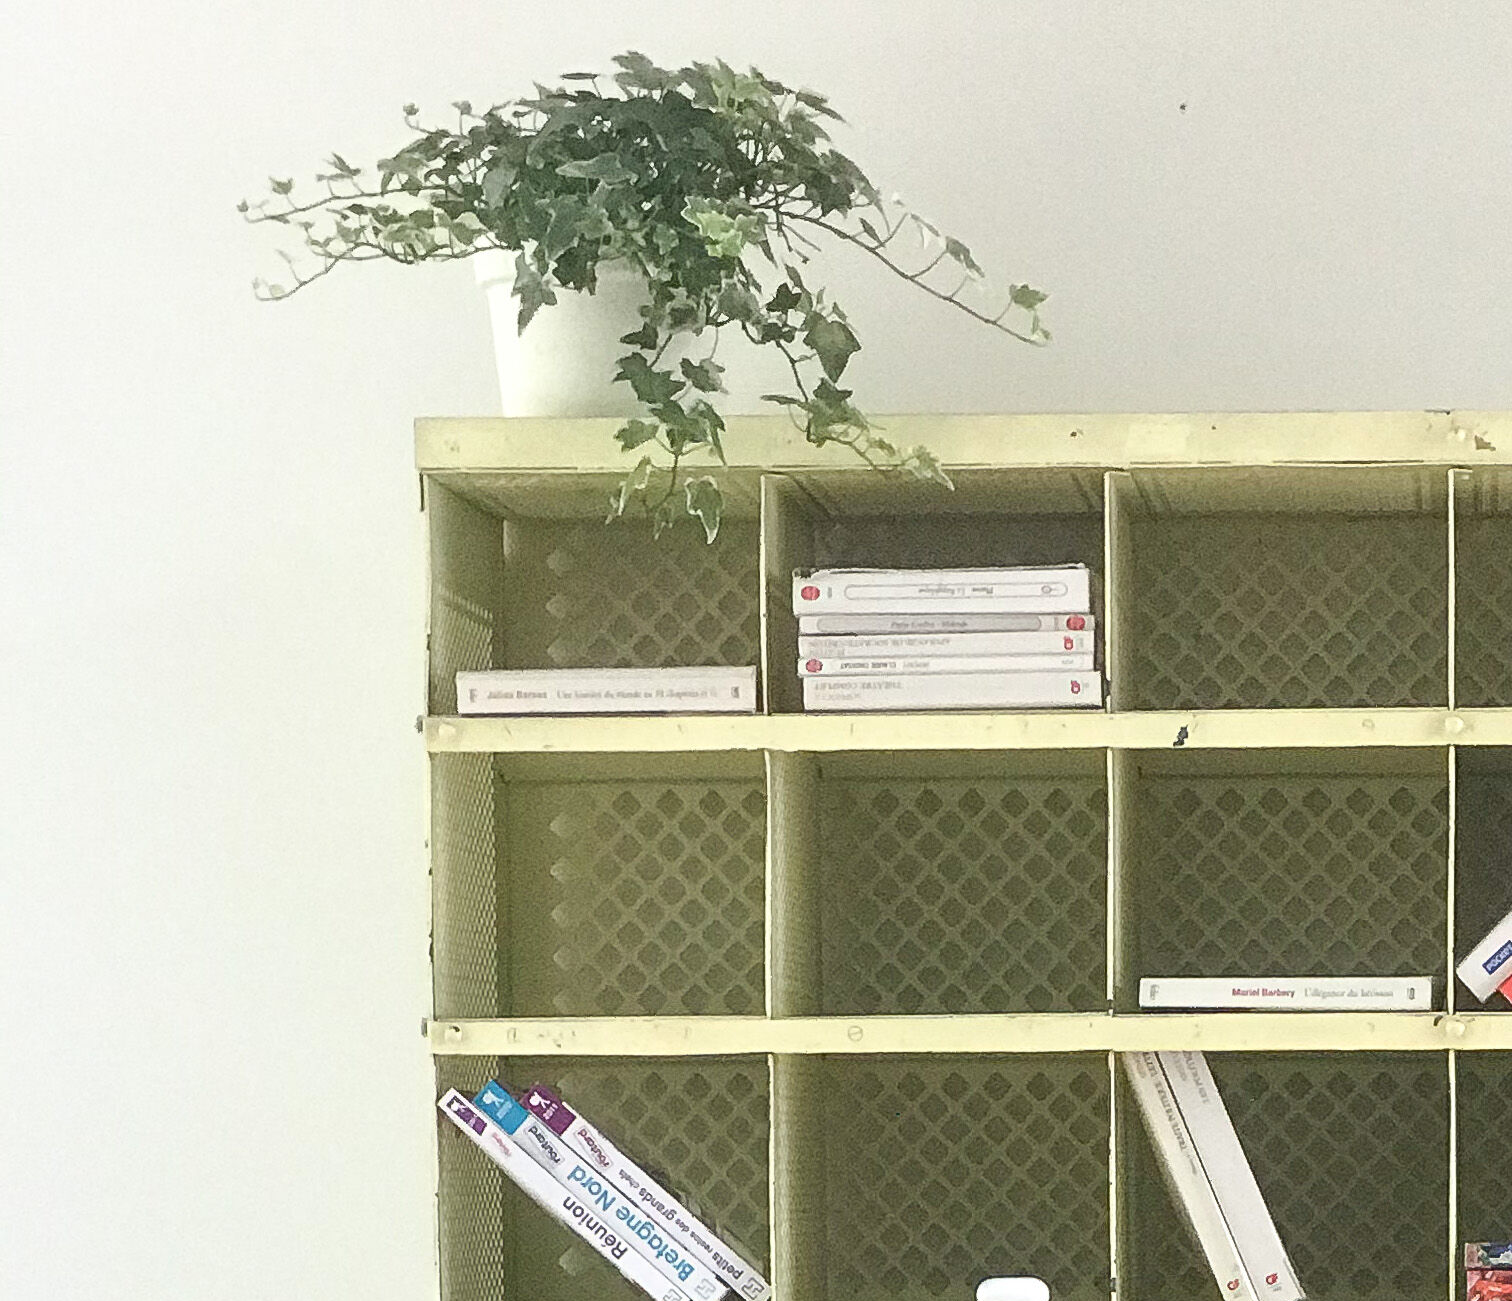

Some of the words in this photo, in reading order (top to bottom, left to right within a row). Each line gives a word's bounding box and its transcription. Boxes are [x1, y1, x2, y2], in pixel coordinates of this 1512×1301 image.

[527, 1125, 561, 1164] routard
[577, 1128, 610, 1168] routard
[566, 1164, 617, 1212] Nord
[638, 1187, 678, 1221] grands
[562, 1196, 628, 1260] Réunion
[615, 1205, 695, 1282] Bretagne
[711, 1251, 745, 1280] petits
